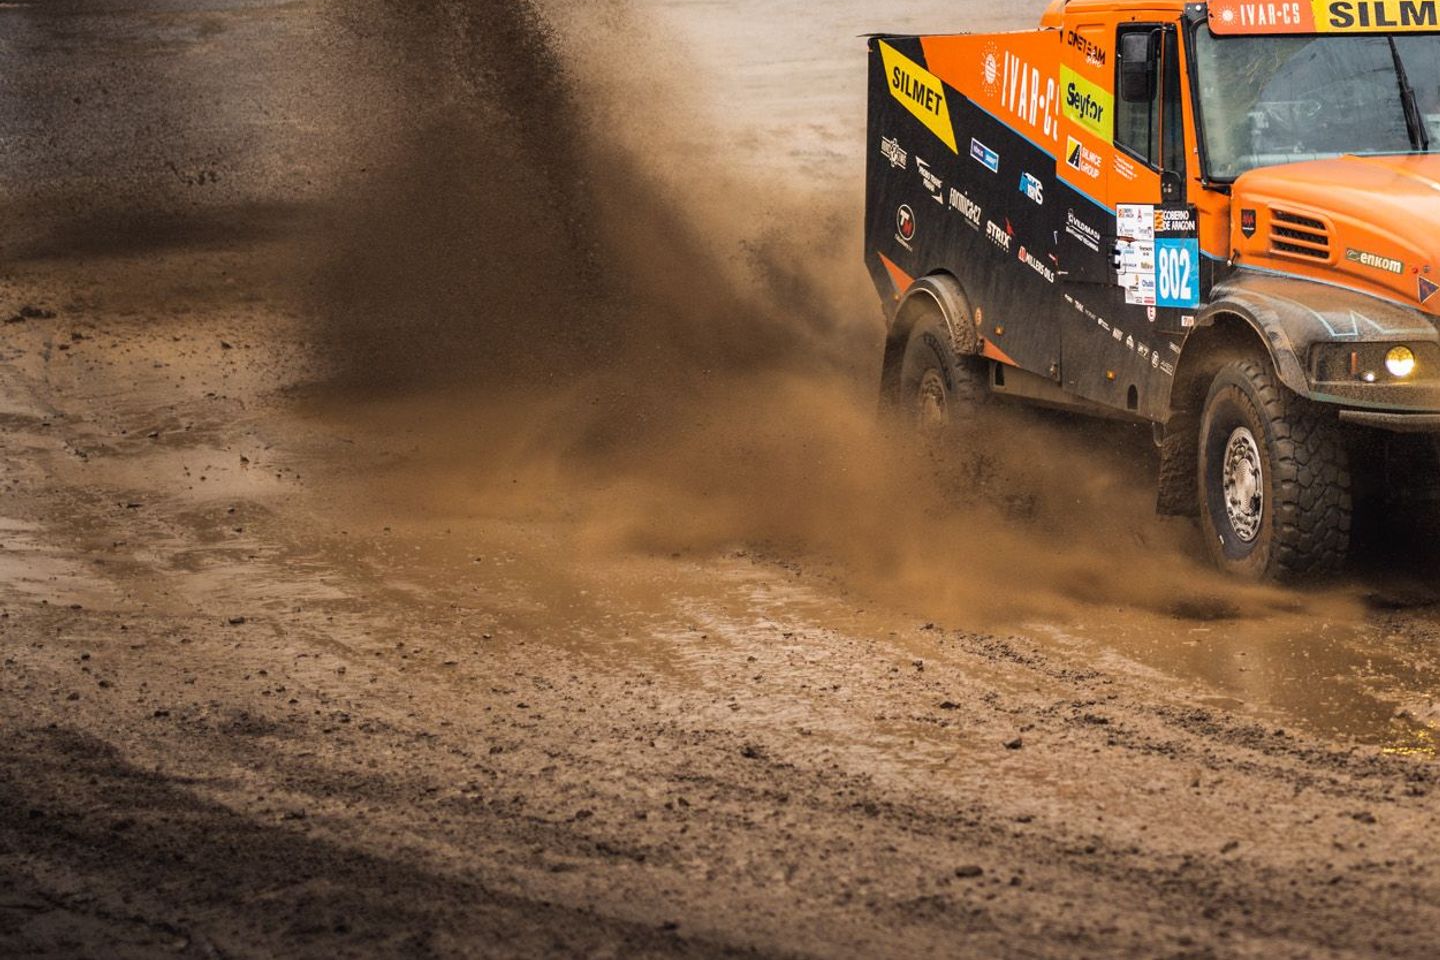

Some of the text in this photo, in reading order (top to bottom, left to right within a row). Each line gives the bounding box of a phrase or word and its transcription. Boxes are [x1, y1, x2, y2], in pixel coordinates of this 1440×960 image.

[892, 66, 943, 116] SILMET
[1066, 82, 1104, 123] Seyfor
[986, 220, 1012, 249] STRIX
[1159, 247, 1192, 300] 802
[1360, 252, 1402, 274] enkom
